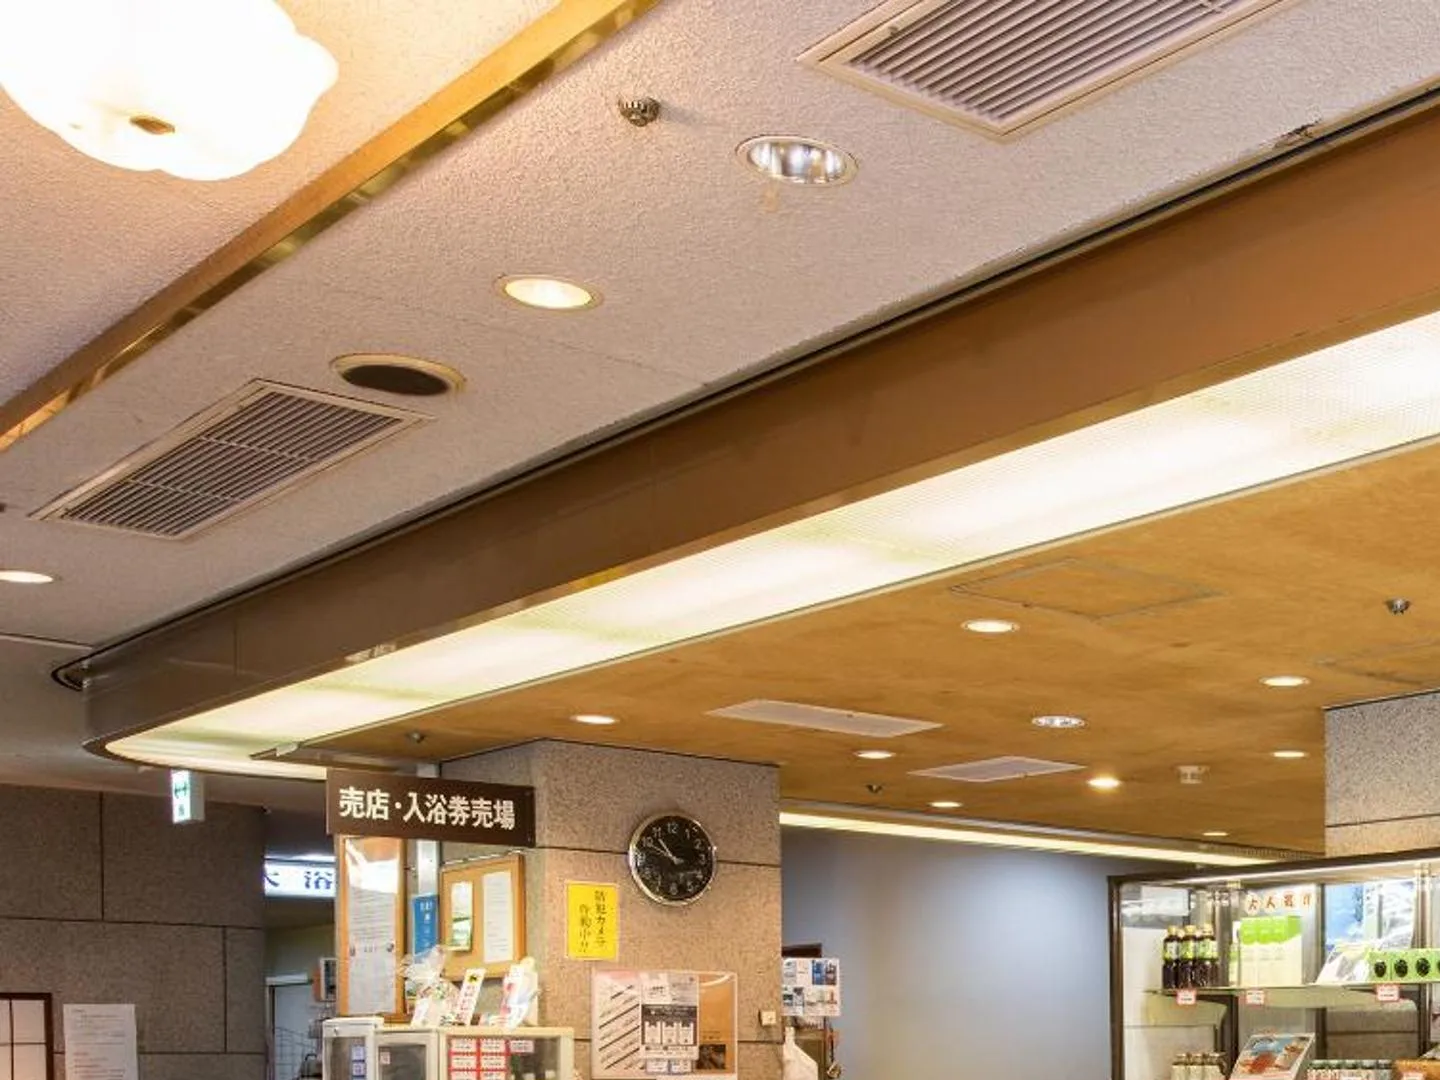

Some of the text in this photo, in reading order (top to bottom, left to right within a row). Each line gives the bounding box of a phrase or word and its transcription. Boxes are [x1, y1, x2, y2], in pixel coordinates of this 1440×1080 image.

[339, 786, 516, 830] 売店・入浴券売場
